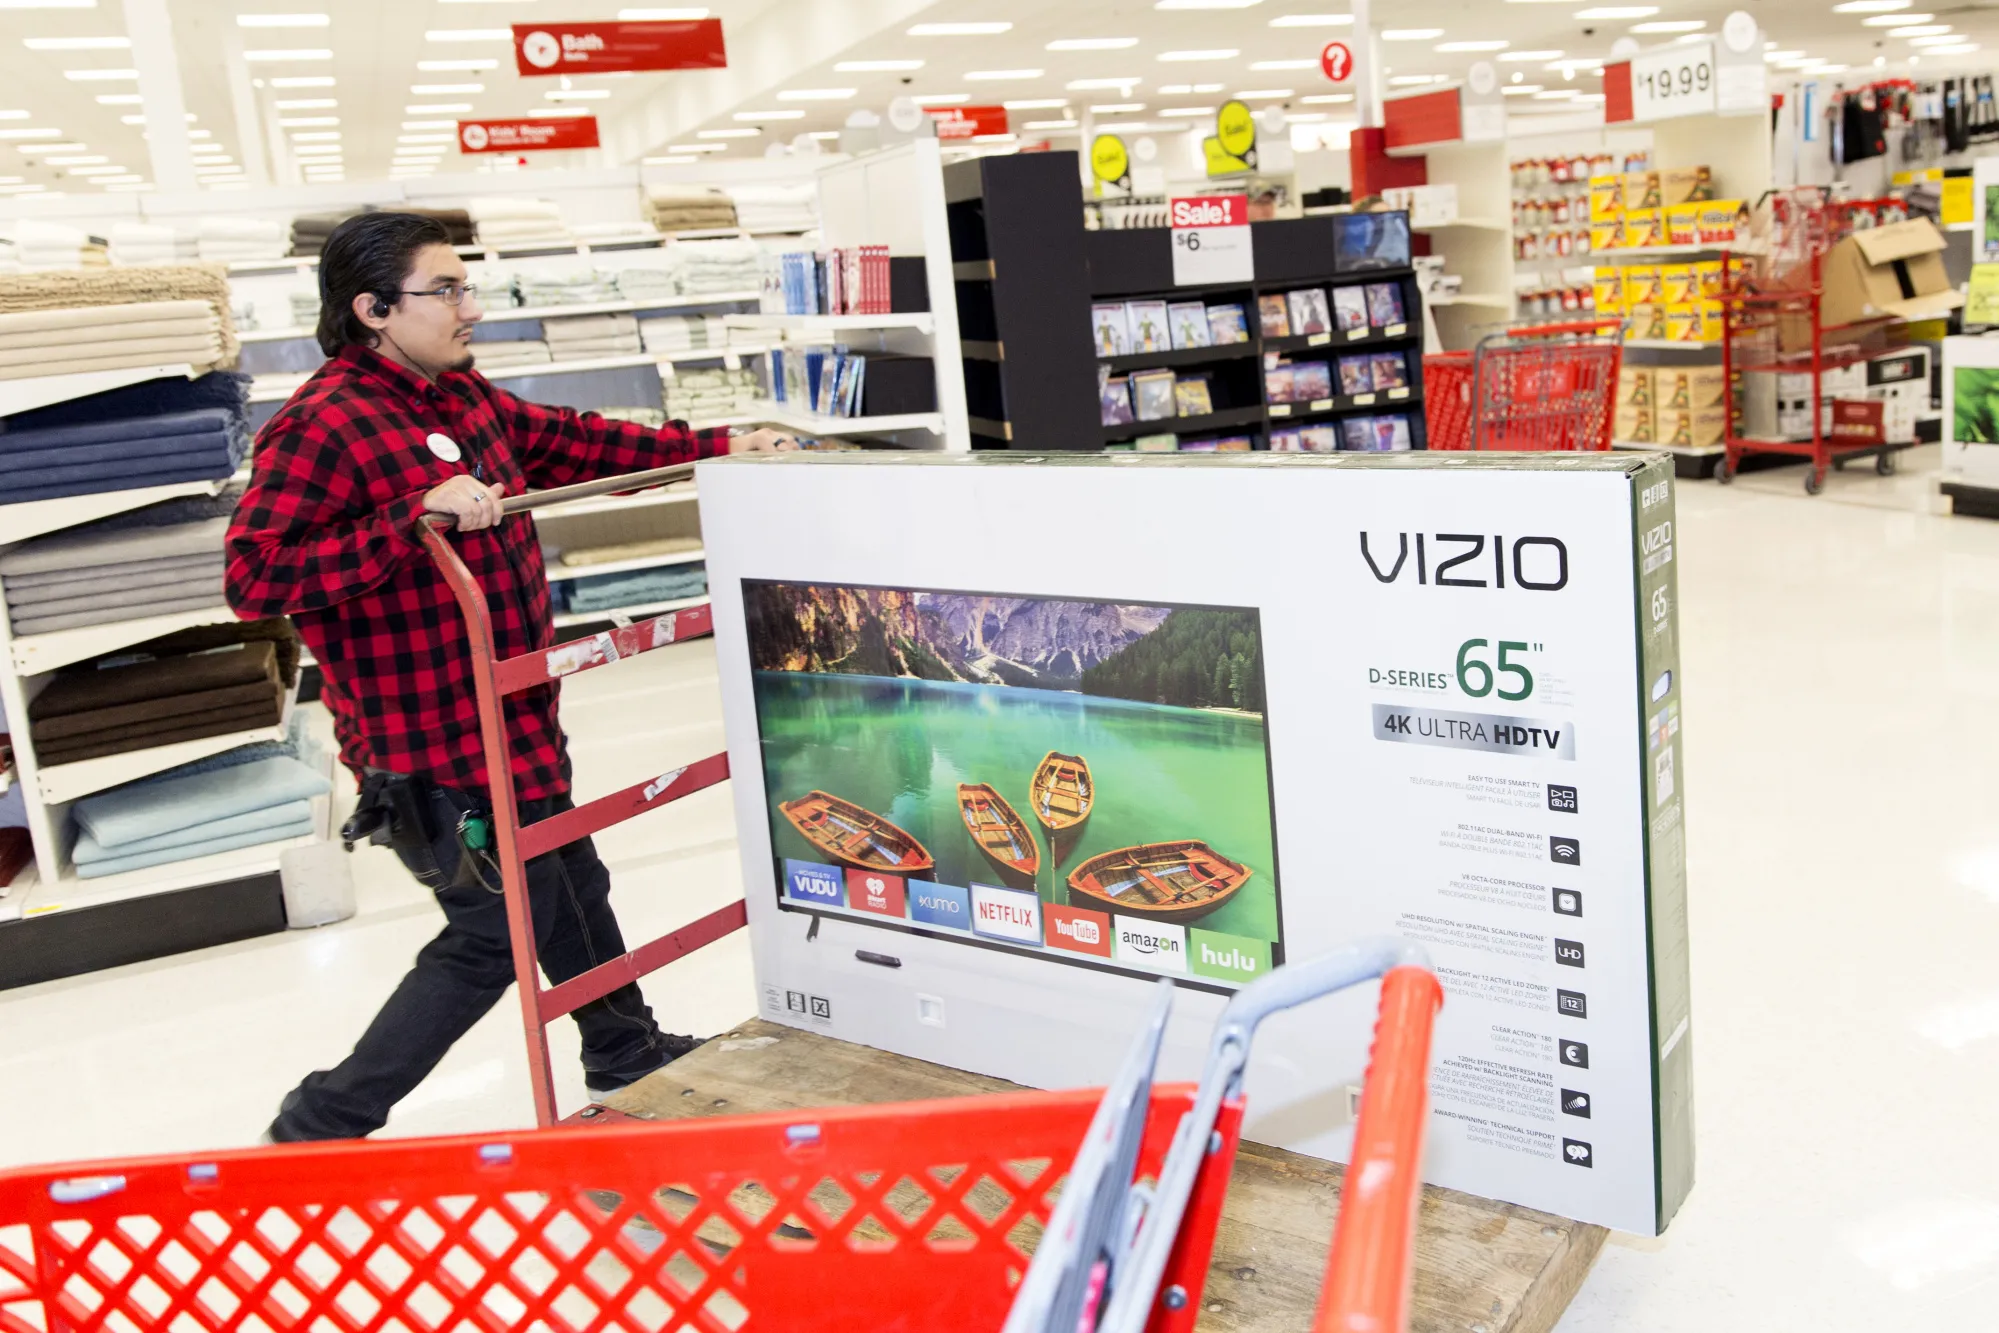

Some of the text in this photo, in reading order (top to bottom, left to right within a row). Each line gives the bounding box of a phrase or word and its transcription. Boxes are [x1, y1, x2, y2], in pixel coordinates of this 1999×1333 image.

[1173, 199, 1232, 226] Sale!
[1176, 231, 1200, 251] $6
[1641, 521, 1672, 555] VIZIO
[1359, 531, 1568, 591] VIZIO
[1384, 713, 1560, 750] 4K ULTRA HDTV
[1495, 777, 1506, 785] USE
[1508, 779, 1530, 787] SMART
[794, 875, 837, 897] VUDU
[1508, 880, 1545, 891] PROCESSOR
[979, 902, 1032, 928] NETFLIX
[1416, 914, 1454, 927] RESOLUTION
[1465, 922, 1490, 932] SPATIAL
[1492, 926, 1518, 937] SCALING
[1054, 918, 1098, 943] YouTube
[1123, 931, 1179, 952] amazon
[1201, 943, 1255, 972] hulu
[1557, 945, 1581, 960] UHD
[1490, 976, 1511, 985] ACTIVE
[1513, 980, 1525, 988] LED
[1566, 999, 1577, 1009] 12
[1491, 1025, 1511, 1034] CLEAR
[1443, 1059, 1473, 1071] ACHIEVED
[1483, 1068, 1518, 1080] BACKLIGHT
[1519, 1075, 1553, 1088] SCANNING
[1477, 1059, 1507, 1071] EFFECTIVE
[1509, 1065, 1536, 1077] REFRESH
[1537, 1071, 1553, 1080] RATE
[1490, 1120, 1524, 1134] TECHNICAL
[1526, 1128, 1555, 1140] SUPPORT
